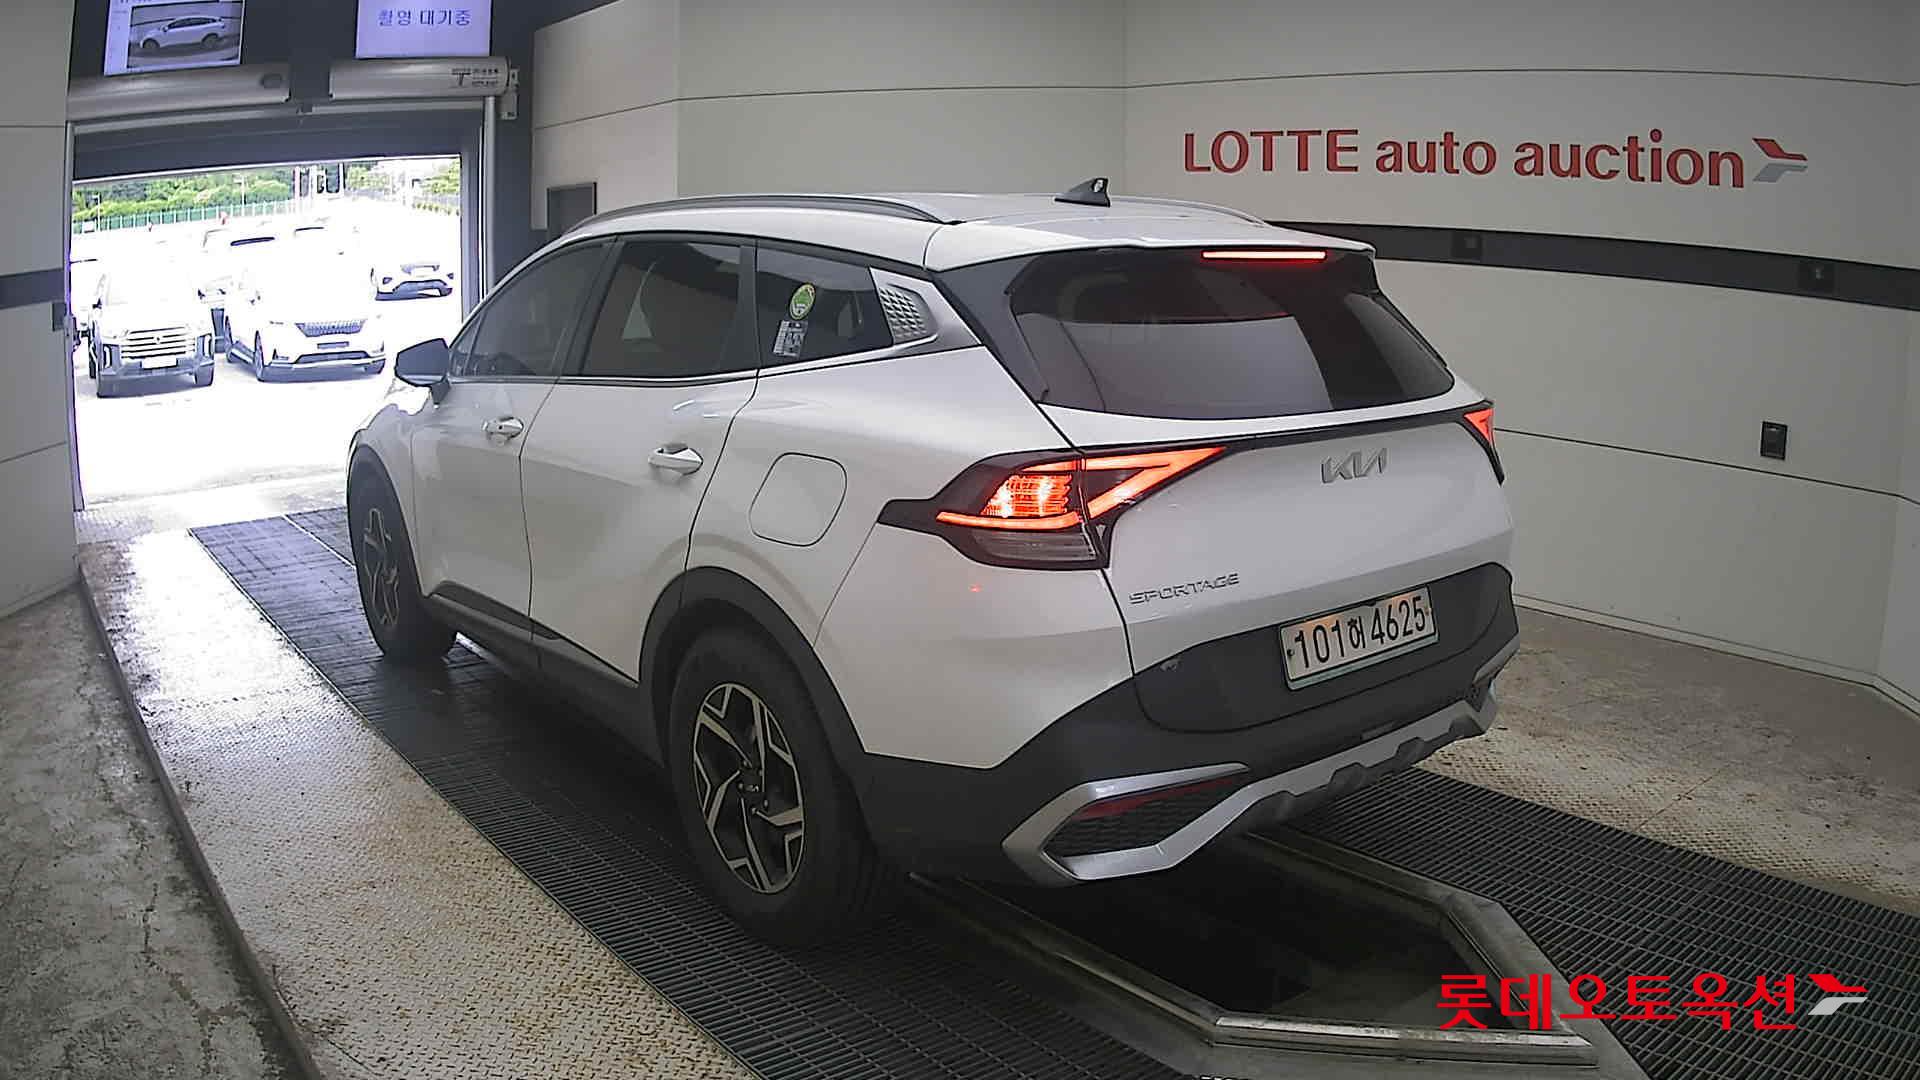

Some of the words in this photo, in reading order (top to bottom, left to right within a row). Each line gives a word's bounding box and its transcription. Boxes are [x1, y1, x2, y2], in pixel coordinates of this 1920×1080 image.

[420, 9, 471, 26] 대기중
[1184, 130, 1359, 172] LOTTE
[1376, 132, 1497, 175] auto
[1514, 129, 1744, 188] auction
[1128, 573, 1240, 605] SPORTAGE
